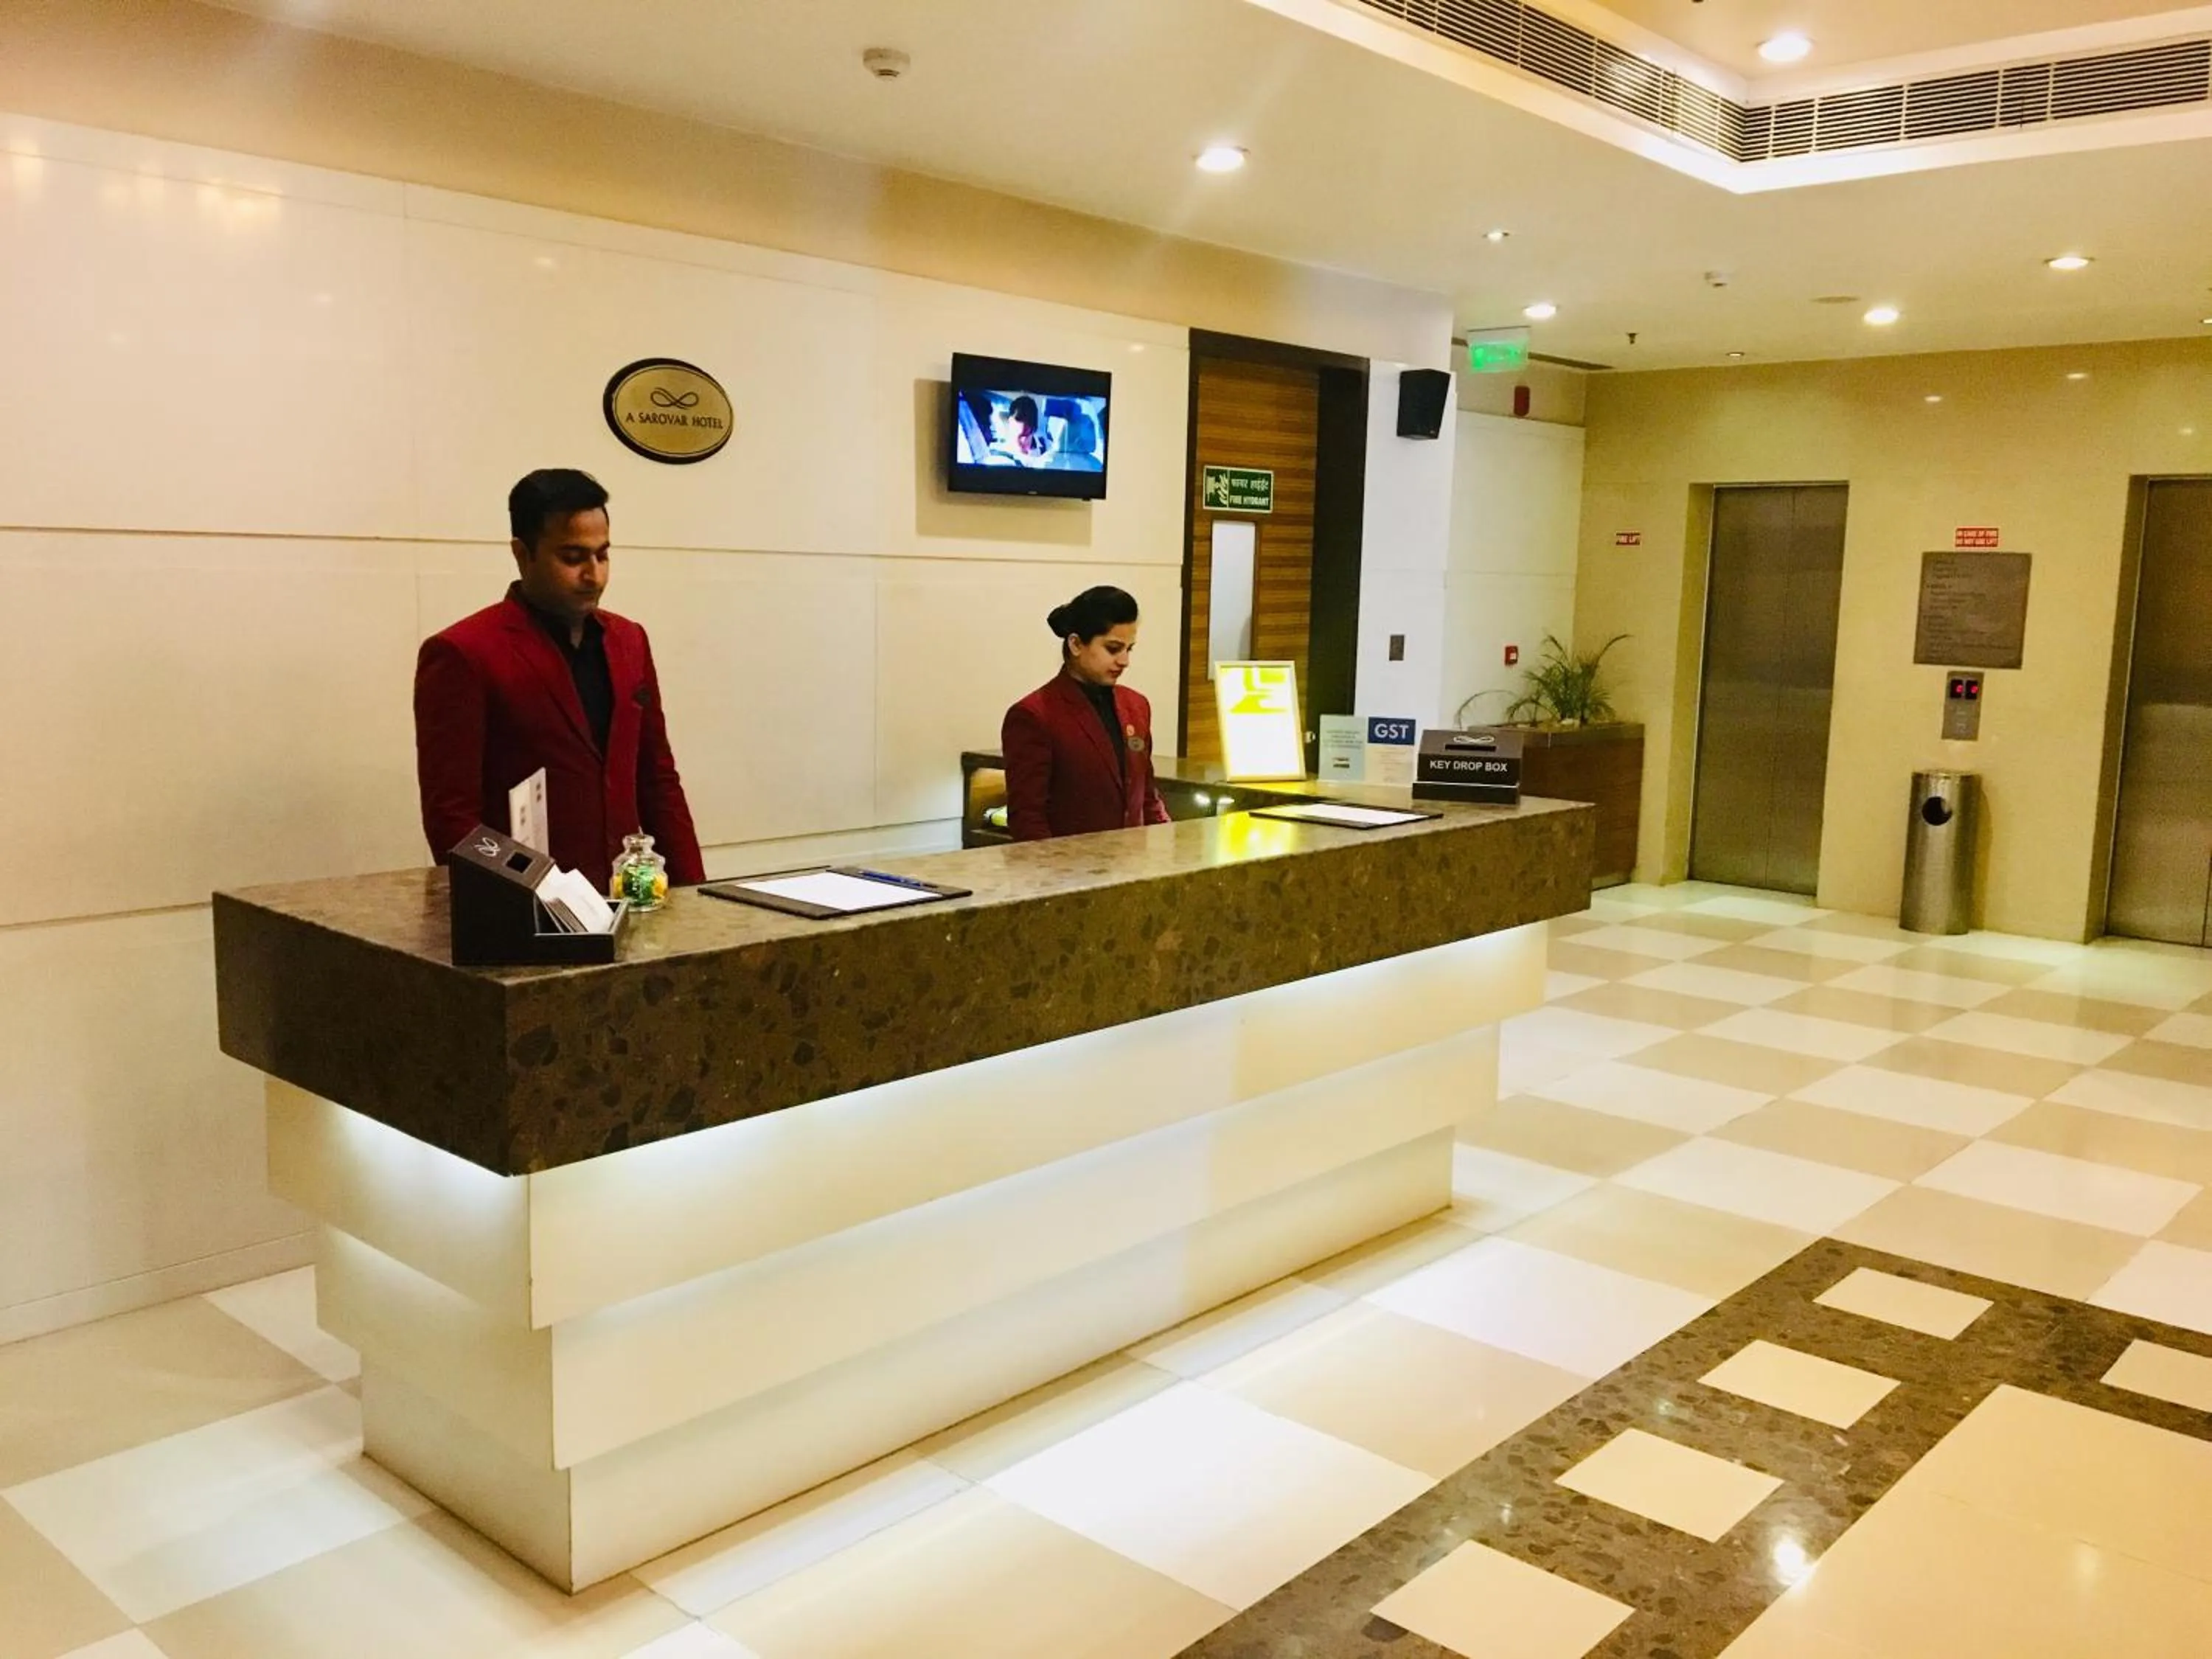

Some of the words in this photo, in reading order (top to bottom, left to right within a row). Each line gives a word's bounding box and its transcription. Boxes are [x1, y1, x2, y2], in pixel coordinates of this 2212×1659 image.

[626, 412, 635, 423] A
[639, 412, 688, 427] SAROVAR
[692, 416, 723, 429] HOTEL
[1374, 723, 1409, 740] GST
[1430, 760, 1451, 770] KEY
[1453, 760, 1484, 771] DROP
[1484, 762, 1509, 772] BOX
